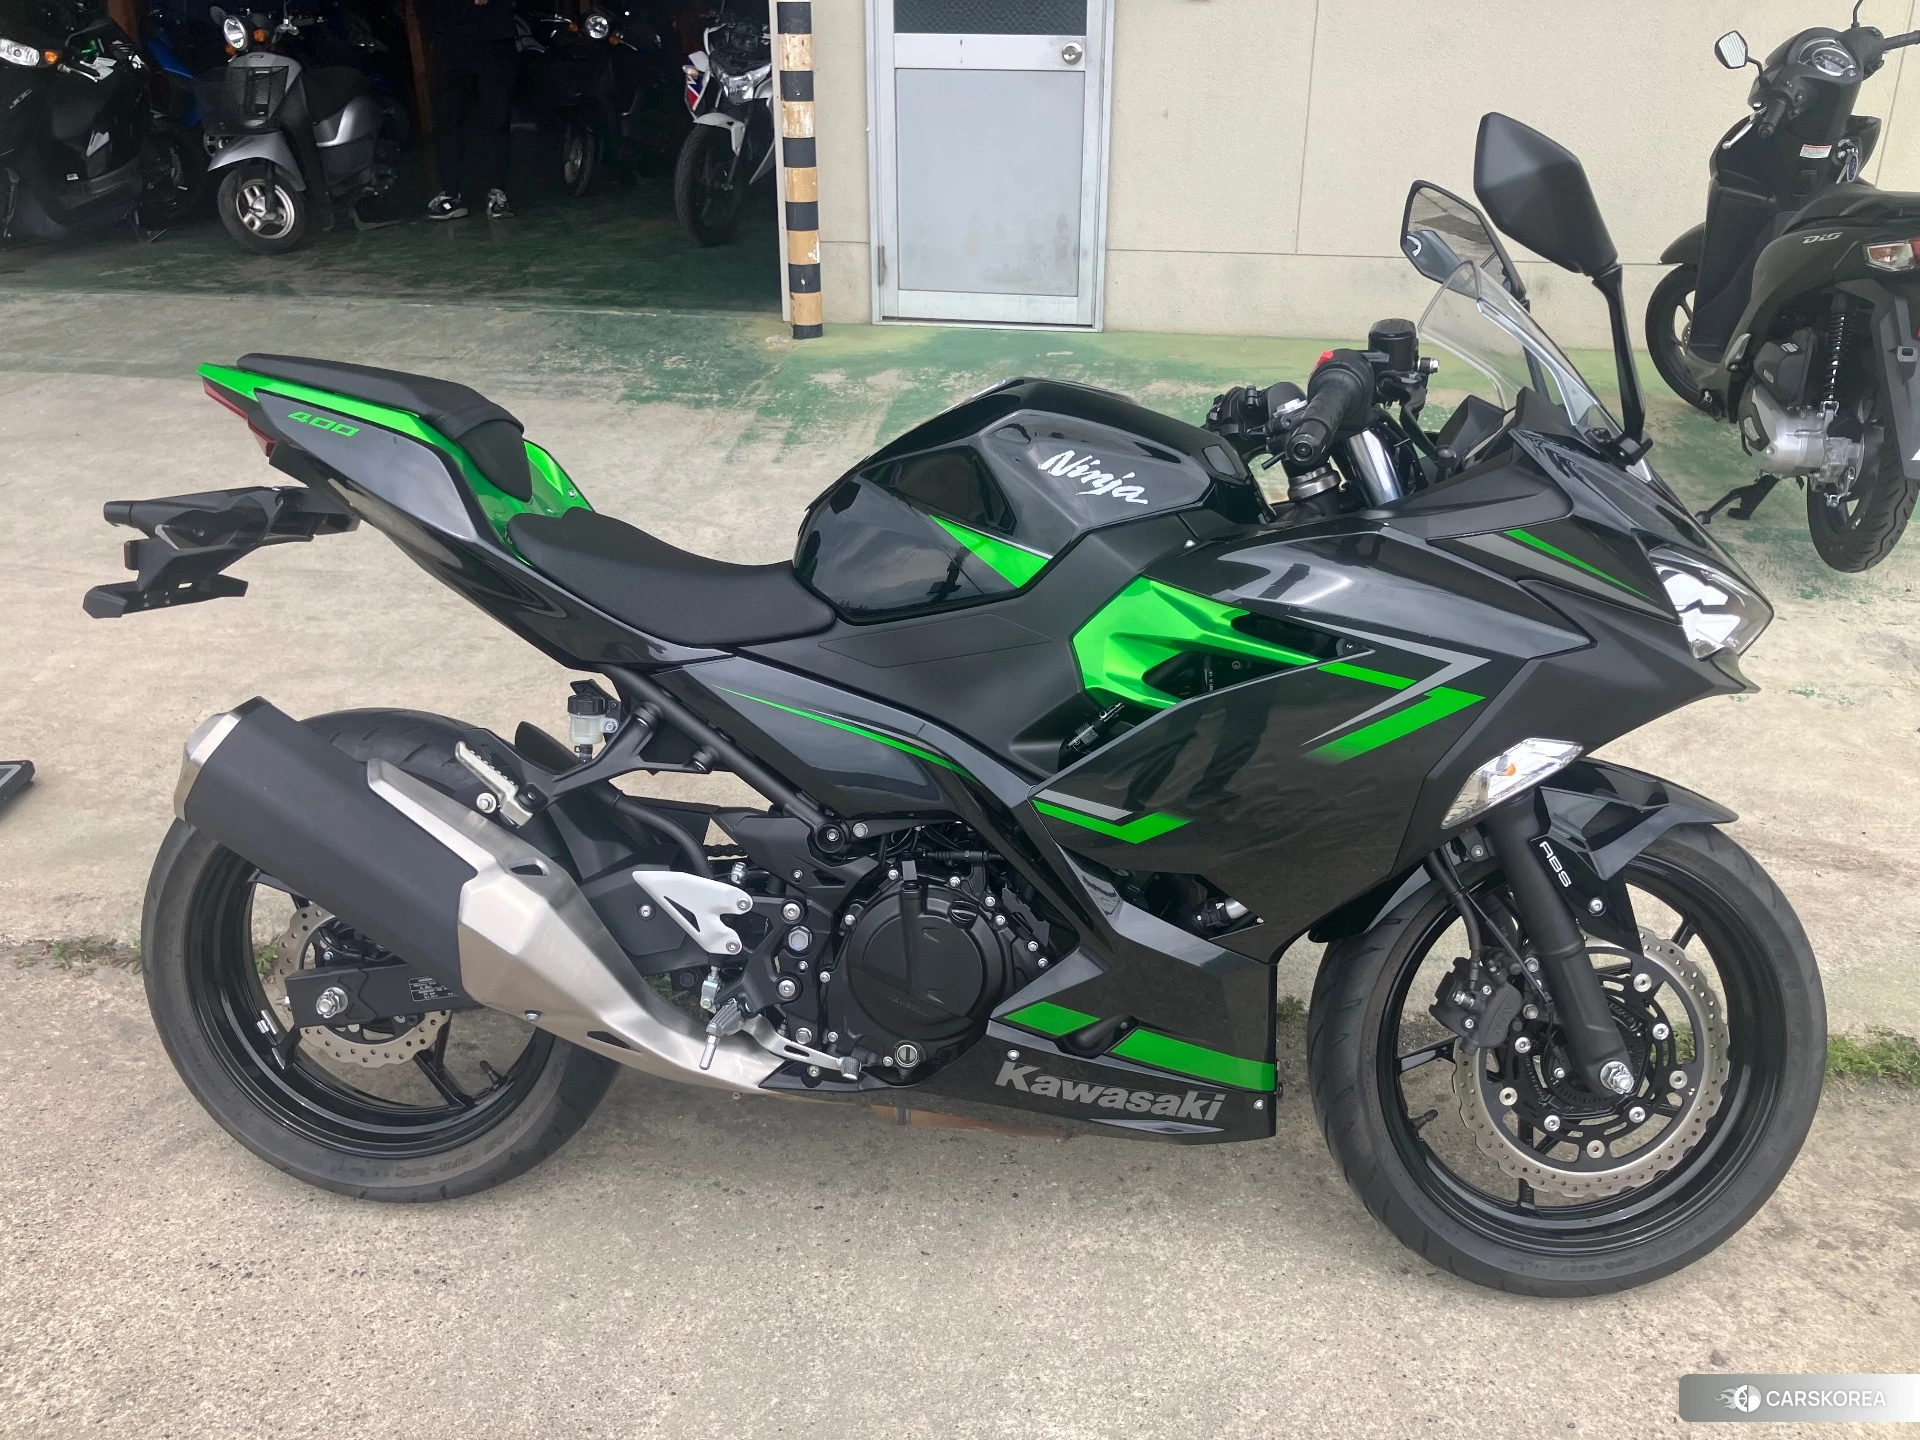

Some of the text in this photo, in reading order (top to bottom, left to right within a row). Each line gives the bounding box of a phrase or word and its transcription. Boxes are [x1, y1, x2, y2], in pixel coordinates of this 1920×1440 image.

[287, 411, 360, 437] 400
[1038, 449, 1149, 505] Ninja
[1539, 840, 1572, 888] ABS
[994, 1060, 1228, 1121] Kawasaki
